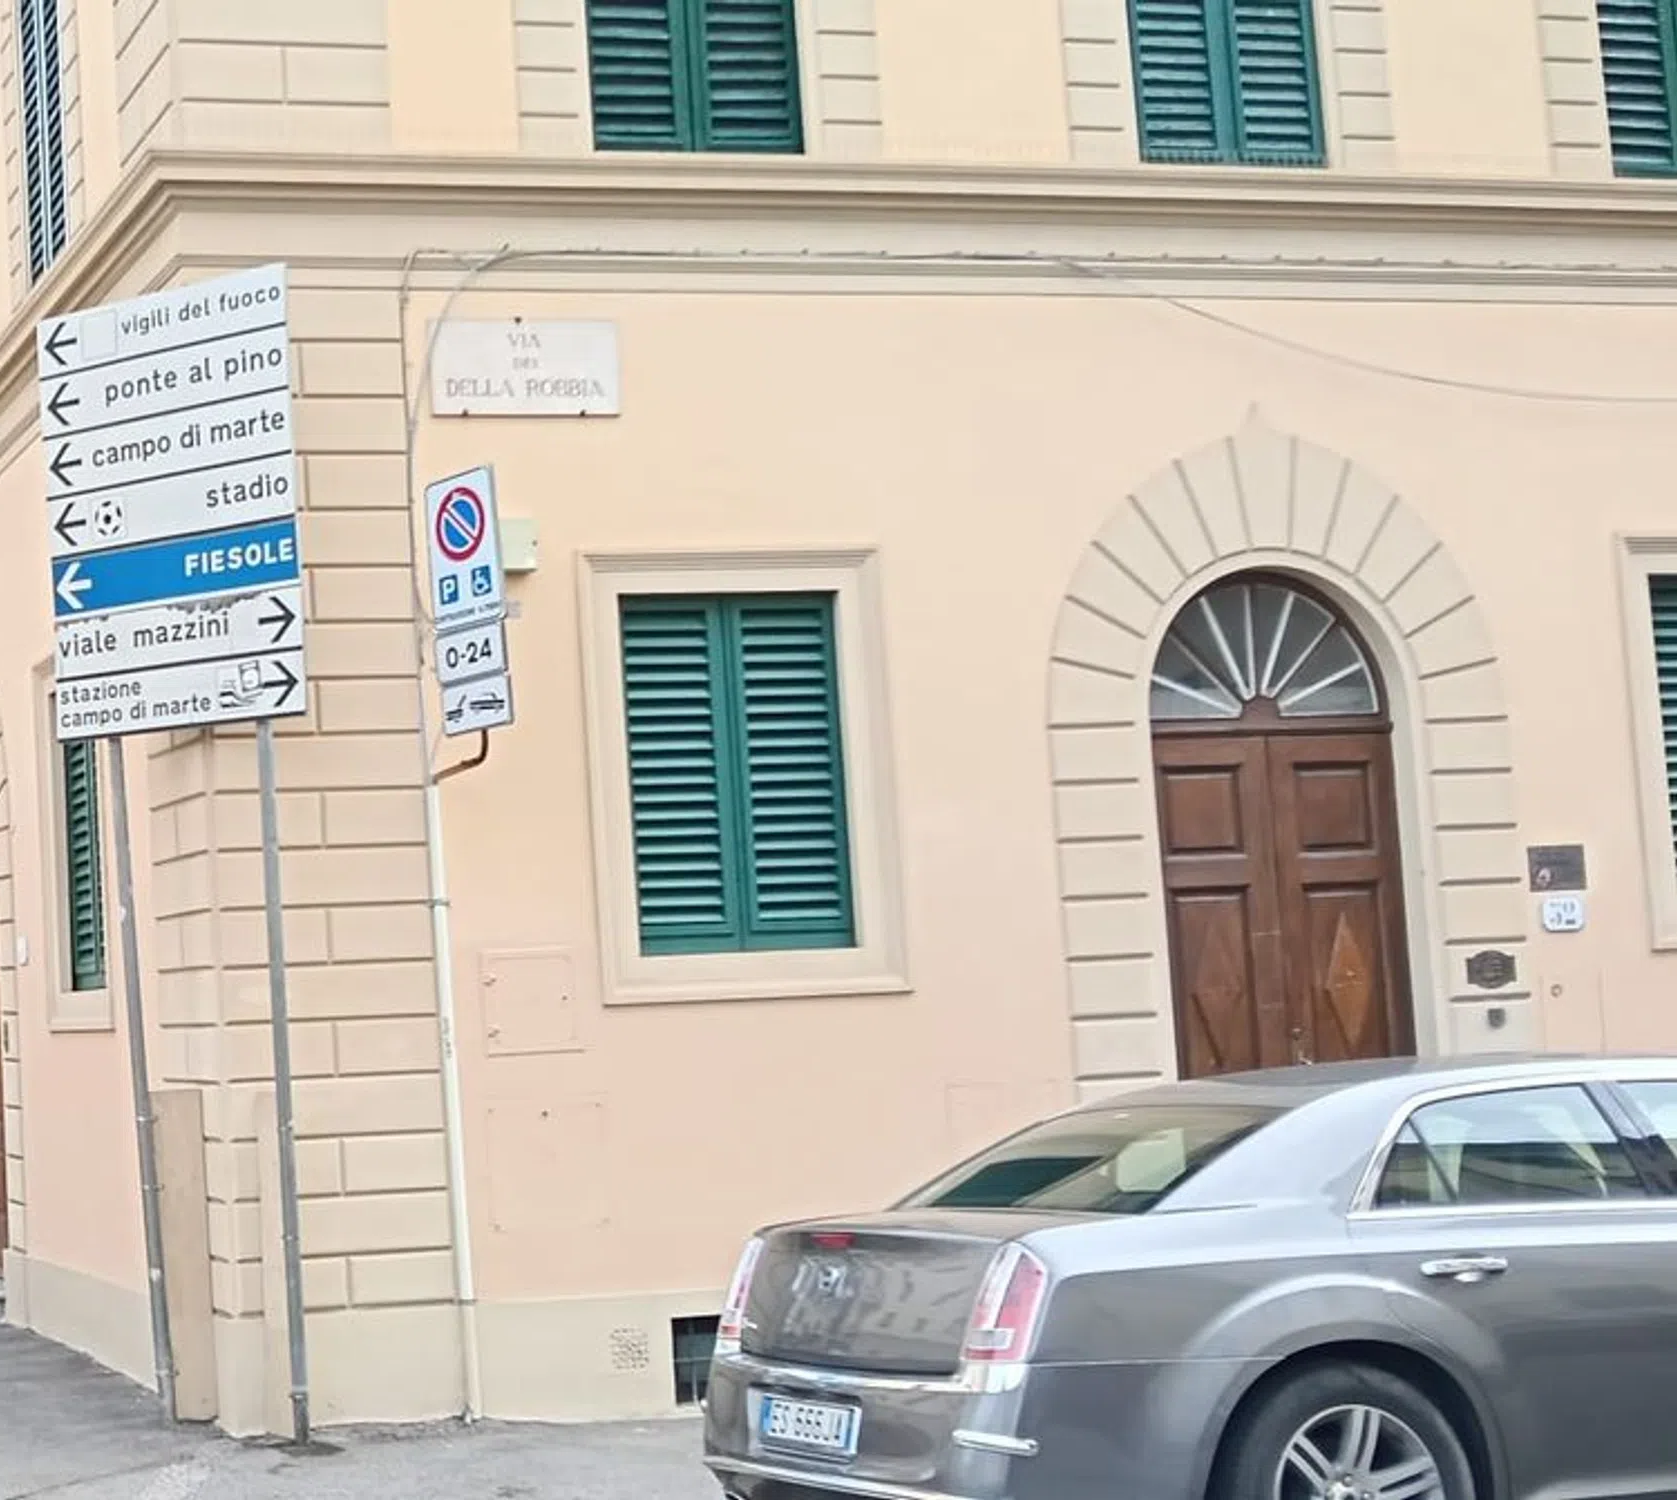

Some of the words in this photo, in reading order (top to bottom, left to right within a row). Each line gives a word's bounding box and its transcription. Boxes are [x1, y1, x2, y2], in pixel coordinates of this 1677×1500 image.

[121, 304, 171, 336] vigili
[178, 296, 211, 322] del
[220, 285, 280, 312] fuoco
[507, 333, 541, 349] VIA
[105, 367, 178, 406] ponte
[188, 356, 213, 383] al
[224, 346, 283, 380] pino
[445, 378, 515, 398] DELLA
[525, 378, 605, 398] ROBBIA
[91, 435, 172, 468] campo
[179, 424, 202, 449] di
[210, 410, 286, 443] marte
[205, 473, 289, 508] stadio
[184, 538, 295, 577] FIESOLE
[58, 626, 117, 659] viale
[133, 614, 229, 649] mazzini
[445, 637, 493, 669] 0-24
[60, 680, 142, 705] stazione
[60, 708, 123, 731] campo
[129, 701, 148, 720] di
[153, 694, 212, 717] marte
